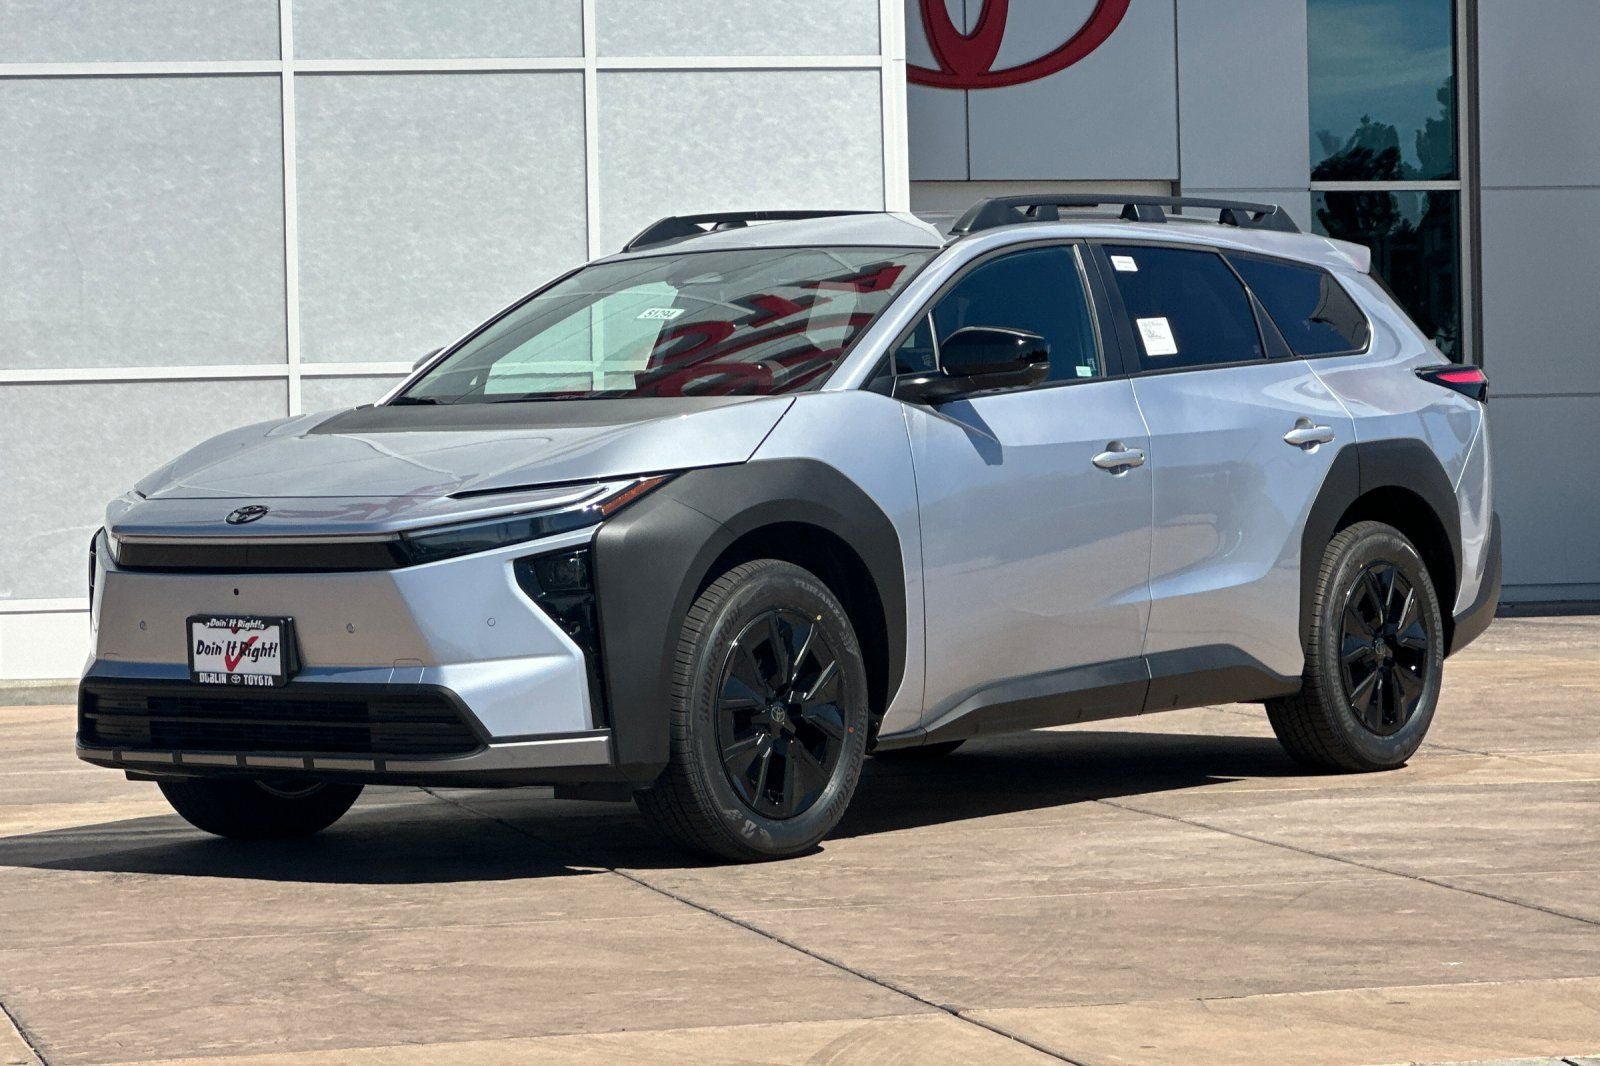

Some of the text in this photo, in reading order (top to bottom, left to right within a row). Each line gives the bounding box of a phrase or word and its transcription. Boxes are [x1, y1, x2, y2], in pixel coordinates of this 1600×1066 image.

[196, 640, 278, 662] Doin' It Right!
[199, 673, 274, 686] DUBLIN TOYOTA
